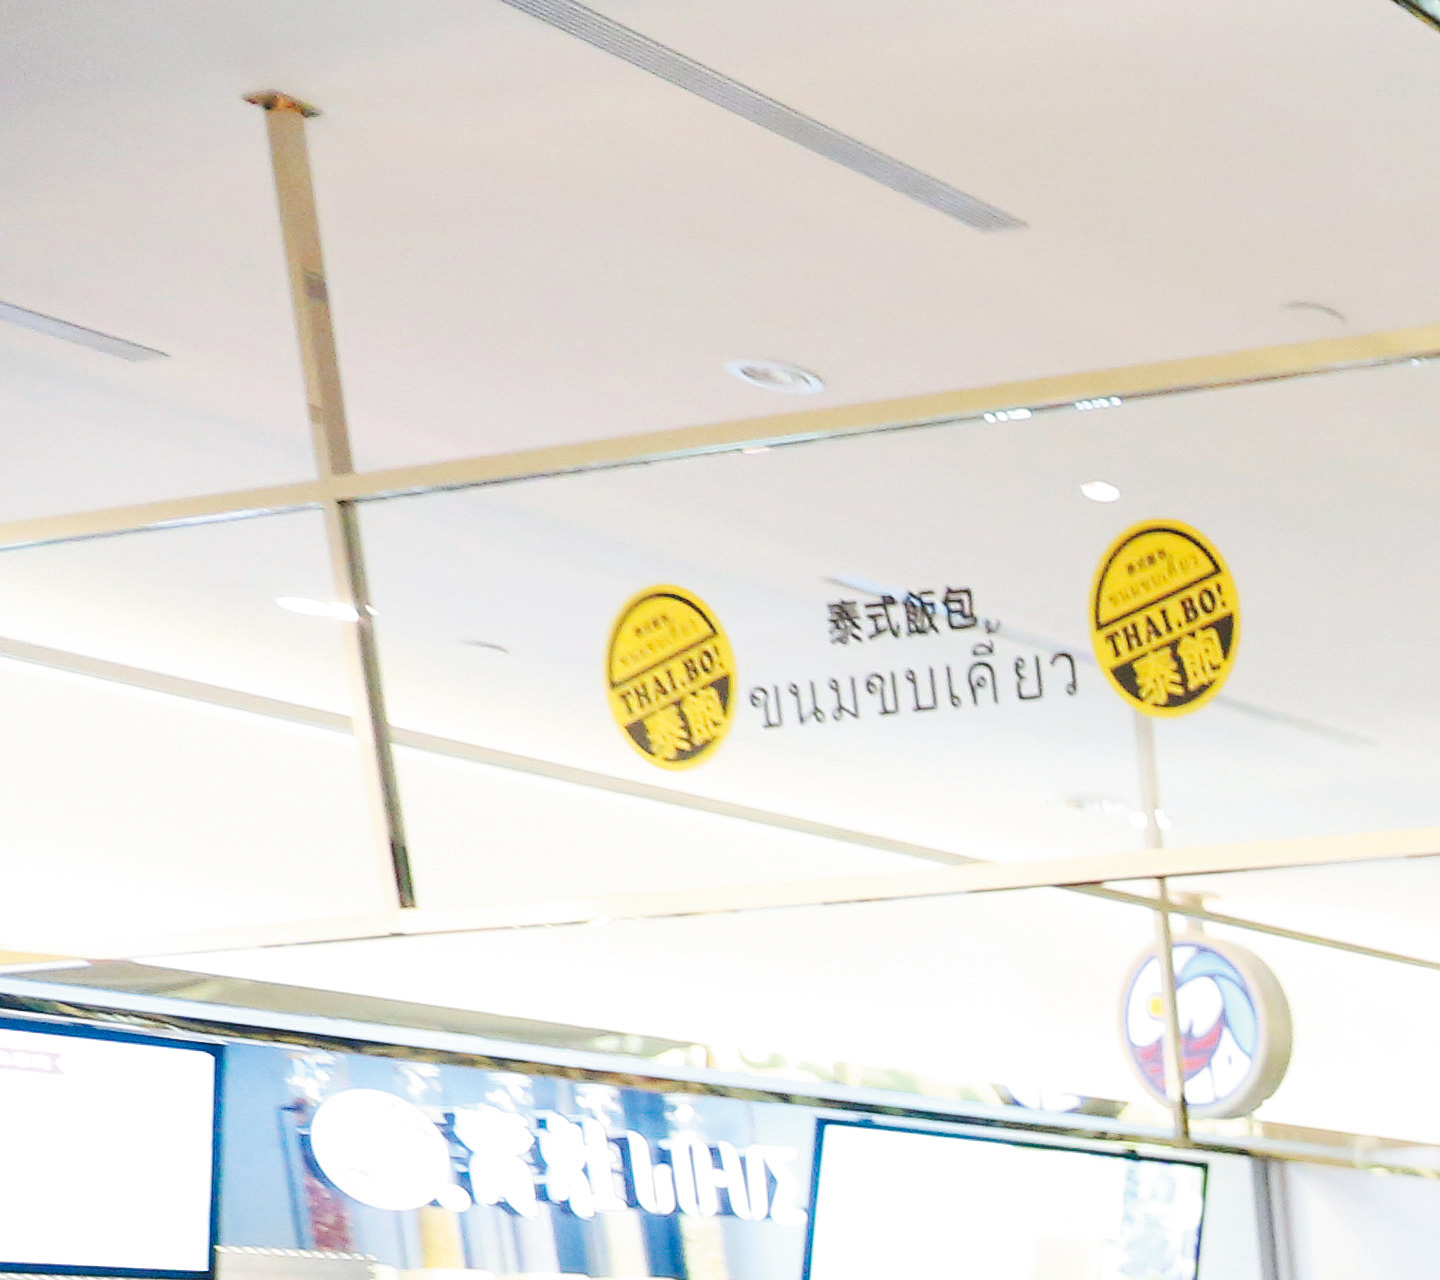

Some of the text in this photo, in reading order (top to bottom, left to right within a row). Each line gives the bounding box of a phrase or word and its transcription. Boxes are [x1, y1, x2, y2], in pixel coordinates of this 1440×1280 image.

[827, 585, 977, 644] 泰式飯包
[1106, 583, 1227, 658] THAI.BO!
